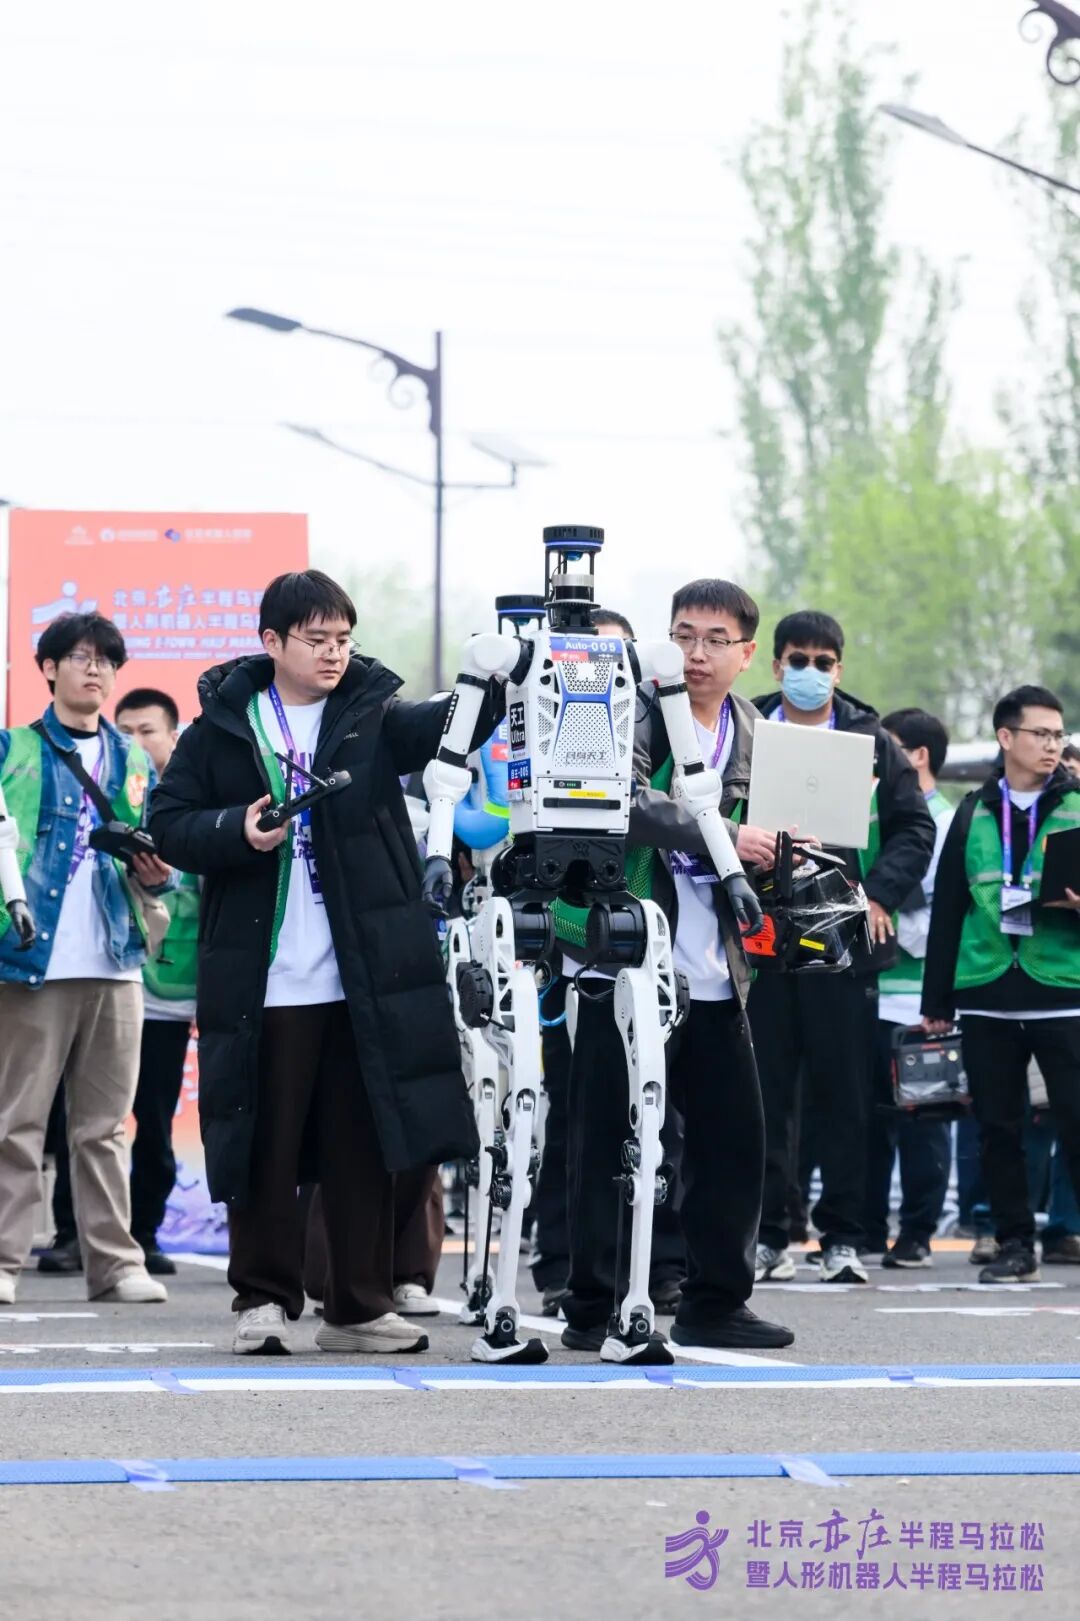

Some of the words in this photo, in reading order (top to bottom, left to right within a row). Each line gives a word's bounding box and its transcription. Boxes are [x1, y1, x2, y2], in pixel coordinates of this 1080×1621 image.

[565, 641, 616, 652] Auto-005
[511, 707, 524, 727] 天工
[511, 729, 525, 744] Ultra
